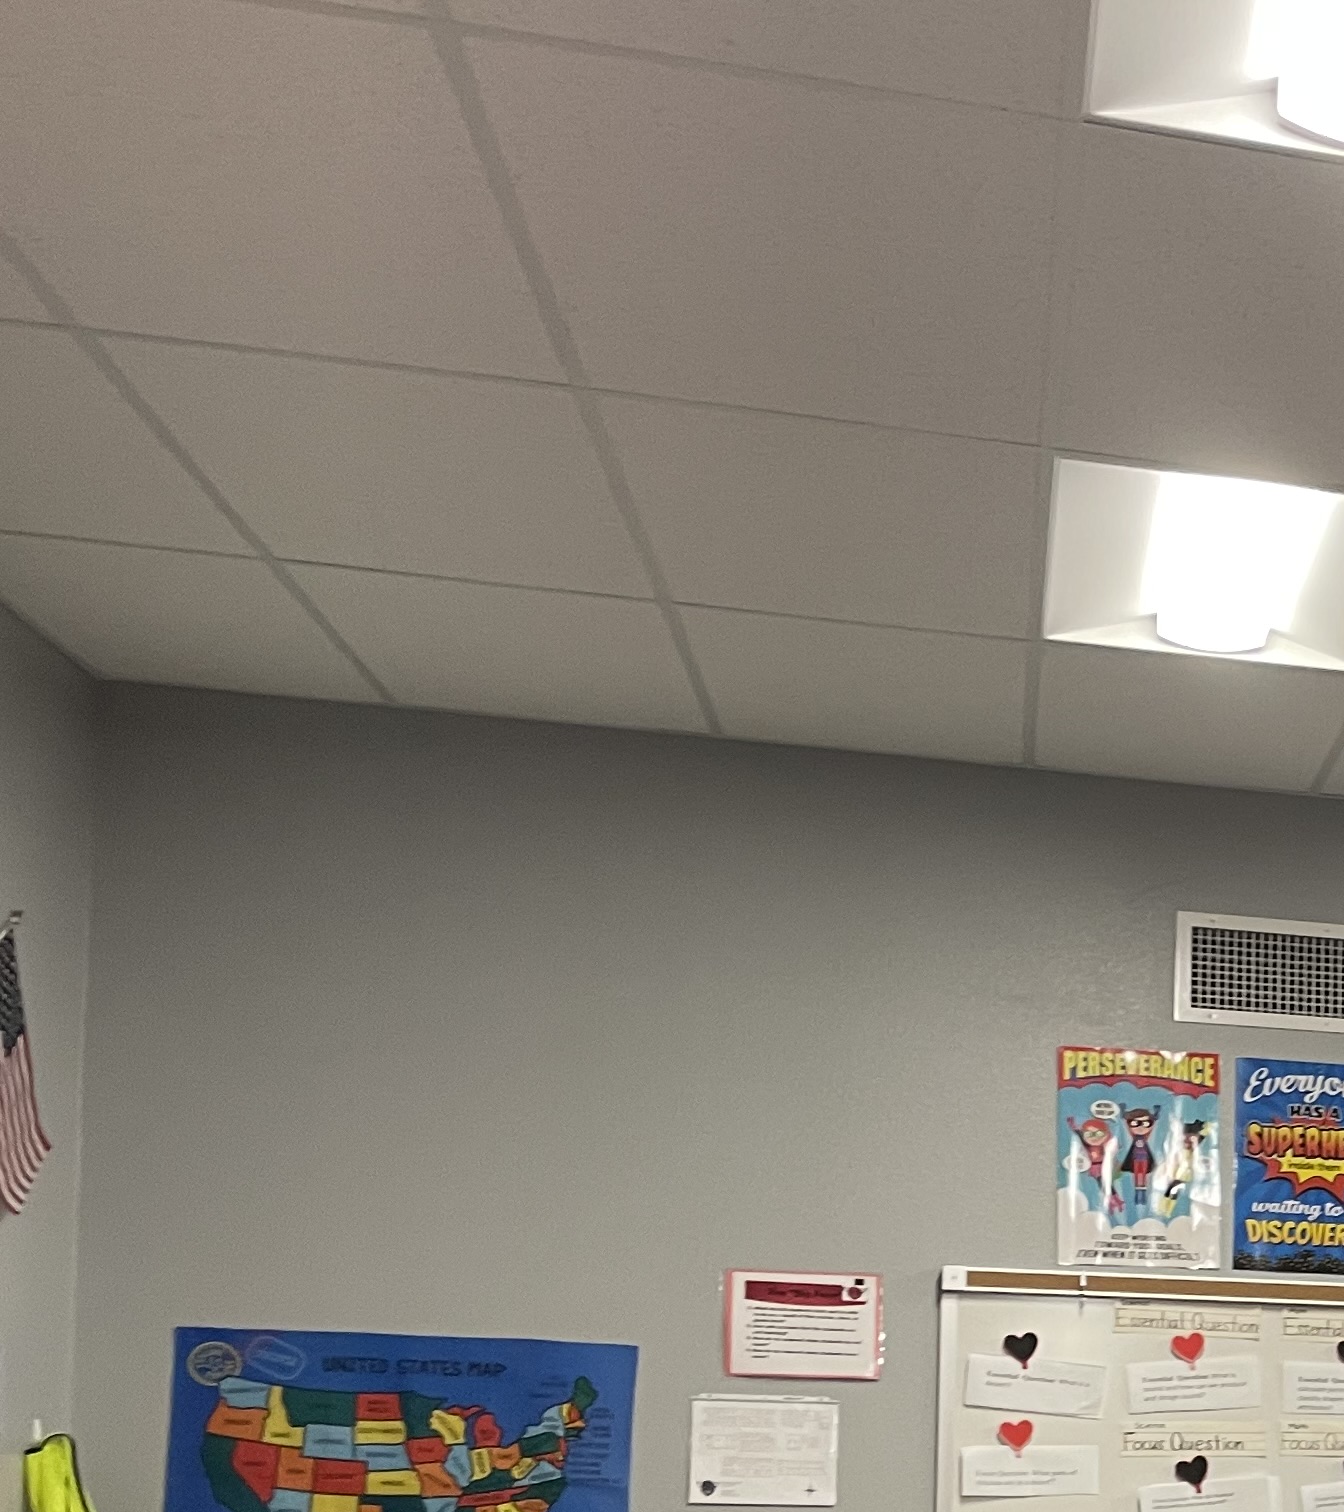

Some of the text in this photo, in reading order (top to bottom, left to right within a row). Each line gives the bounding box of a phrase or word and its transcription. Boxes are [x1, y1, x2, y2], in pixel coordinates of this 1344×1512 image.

[1063, 1051, 1215, 1087] PERSEVERANCE
[1289, 1104, 1342, 1120] HAS A
[1252, 1200, 1322, 1221] waiting
[1325, 1202, 1344, 1217] to
[1115, 1311, 1184, 1330] Essential
[1283, 1317, 1344, 1337] Essential
[1123, 1431, 1245, 1451] Focus Question
